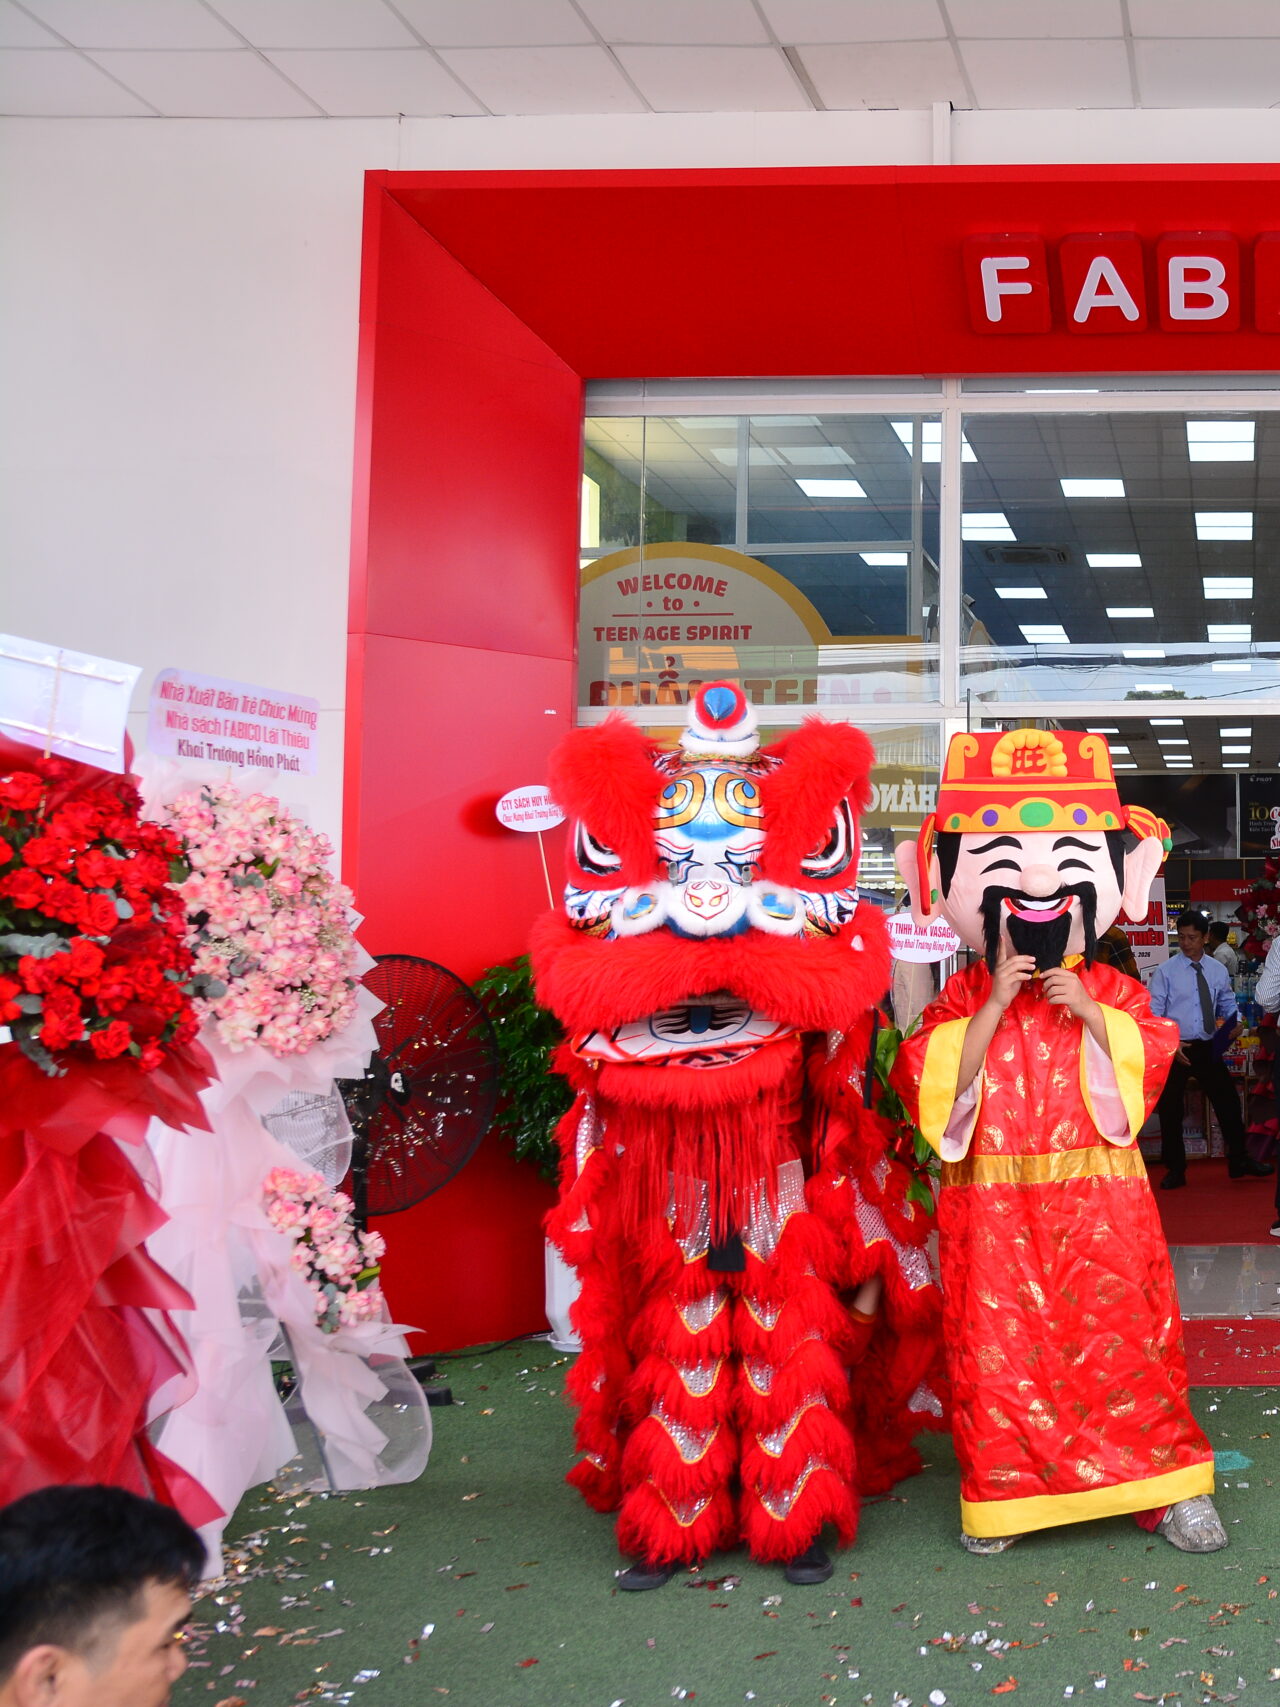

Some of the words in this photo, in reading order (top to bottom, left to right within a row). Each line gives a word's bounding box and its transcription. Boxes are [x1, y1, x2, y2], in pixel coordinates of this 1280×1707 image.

[617, 572, 729, 597] WELCOME
[663, 596, 684, 612] to
[593, 625, 680, 642] TEENAGE
[686, 625, 752, 641] SPIRIT
[258, 698, 286, 720] Chúc
[191, 714, 221, 736] sách
[223, 719, 261, 742] FABICO
[177, 738, 204, 759] Khai
[276, 752, 301, 772] Phát
[502, 799, 513, 811] CTY
[895, 923, 912, 935] TNHH
